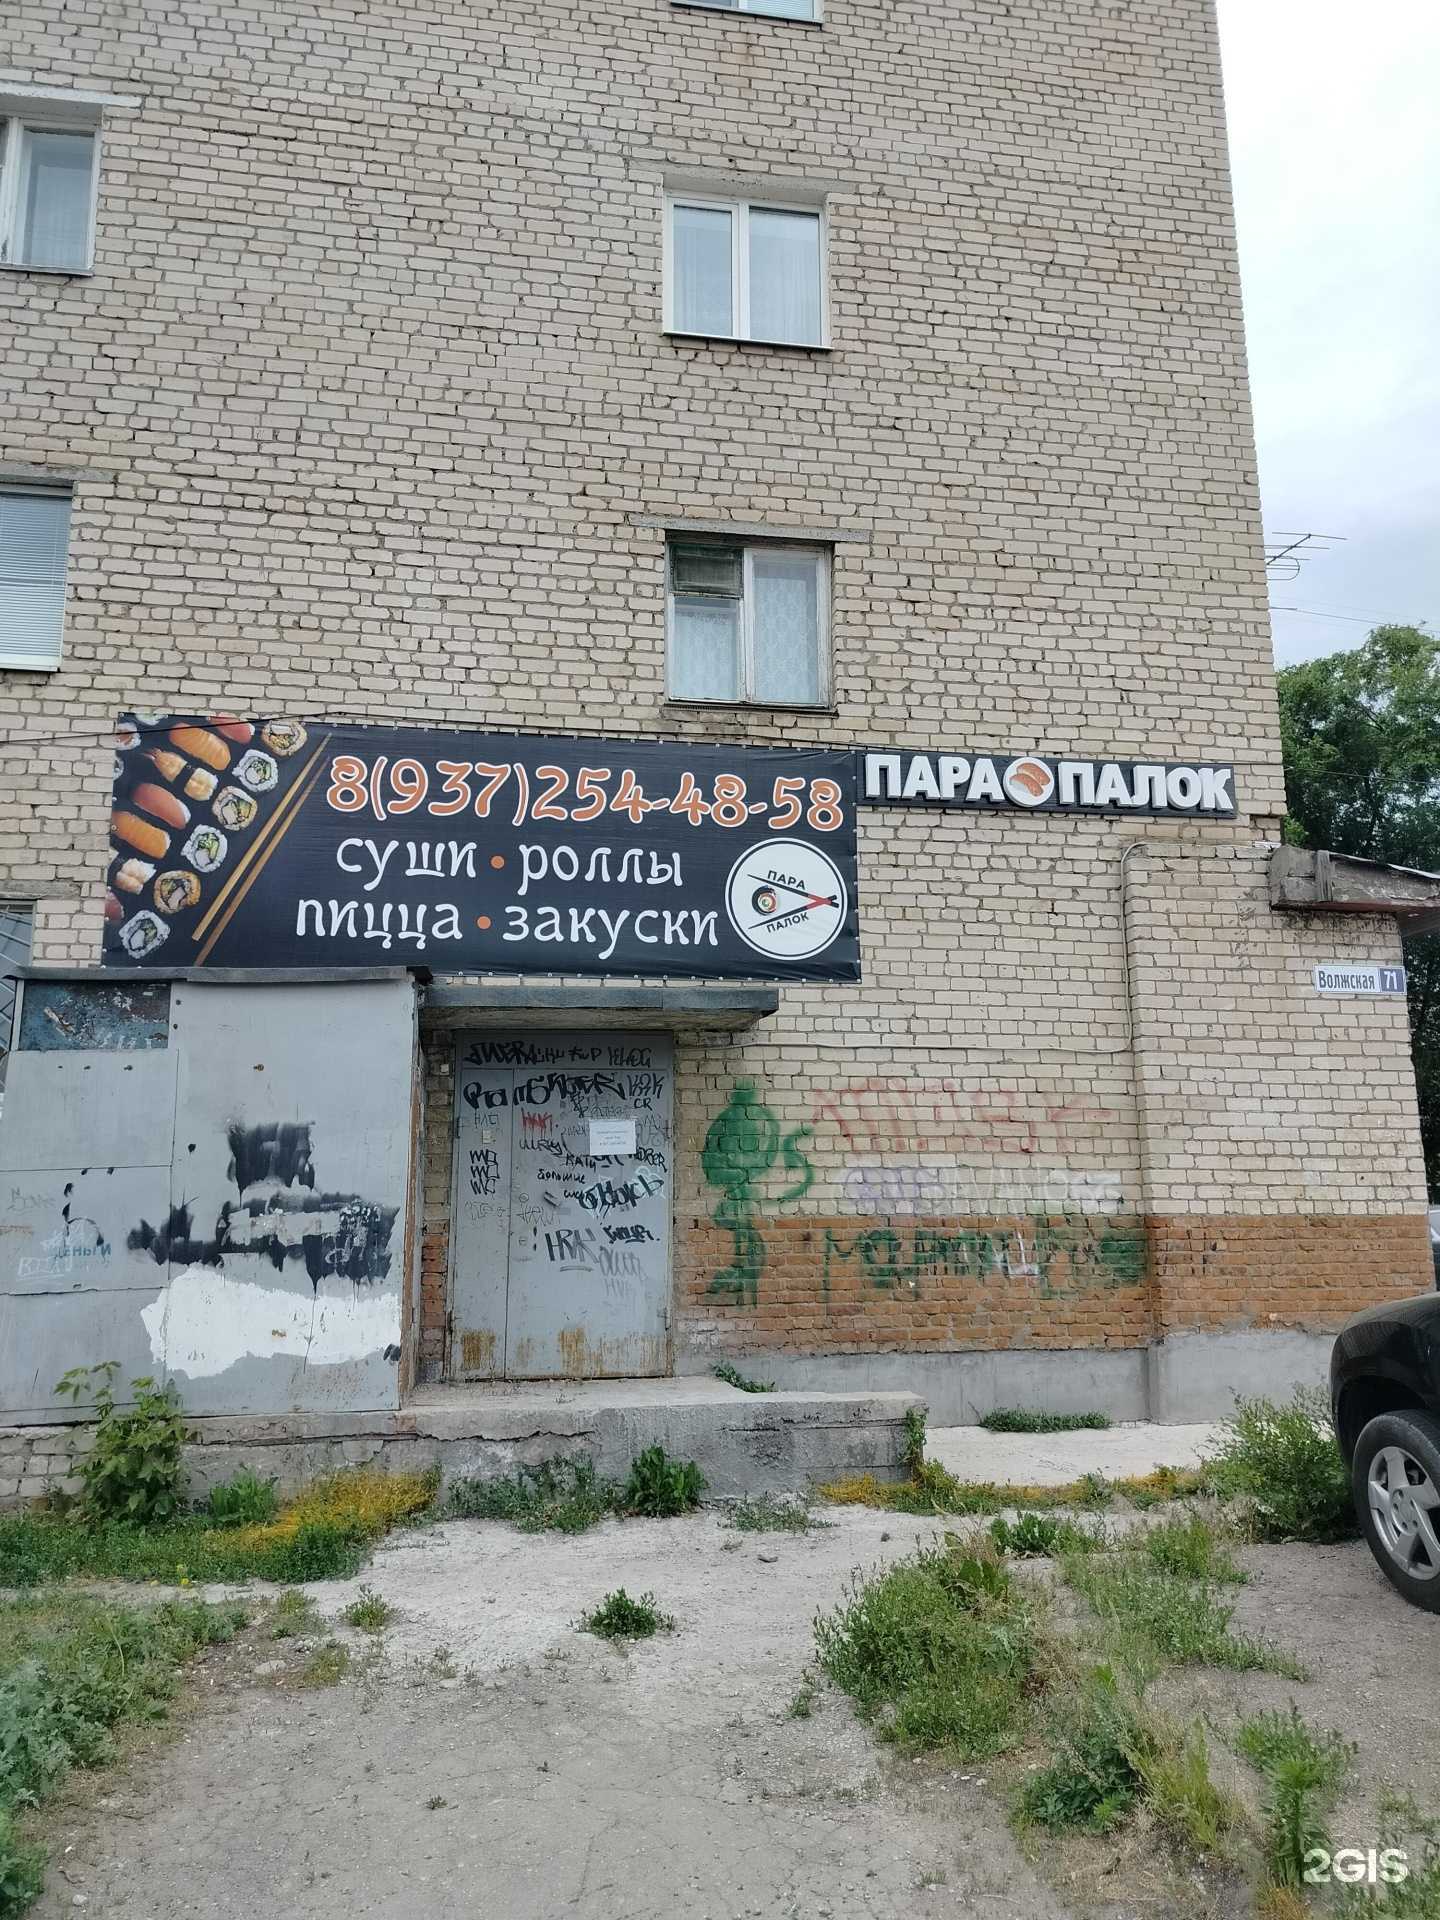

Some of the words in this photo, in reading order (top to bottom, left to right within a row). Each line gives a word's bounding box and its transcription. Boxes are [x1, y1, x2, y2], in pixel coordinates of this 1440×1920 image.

[327, 755, 844, 832] 8(937)254-48-58
[865, 754, 1004, 801] ПАРА
[1058, 761, 1234, 811] ПАЛОК
[336, 838, 477, 891] суши
[517, 844, 683, 896] роллы
[767, 870, 806, 890] ПАРА
[296, 897, 463, 950] пицца
[502, 905, 719, 960] закуски
[766, 911, 810, 933] ПАЛОК
[1318, 970, 1376, 990] Волжская
[1384, 970, 1398, 990] 71
